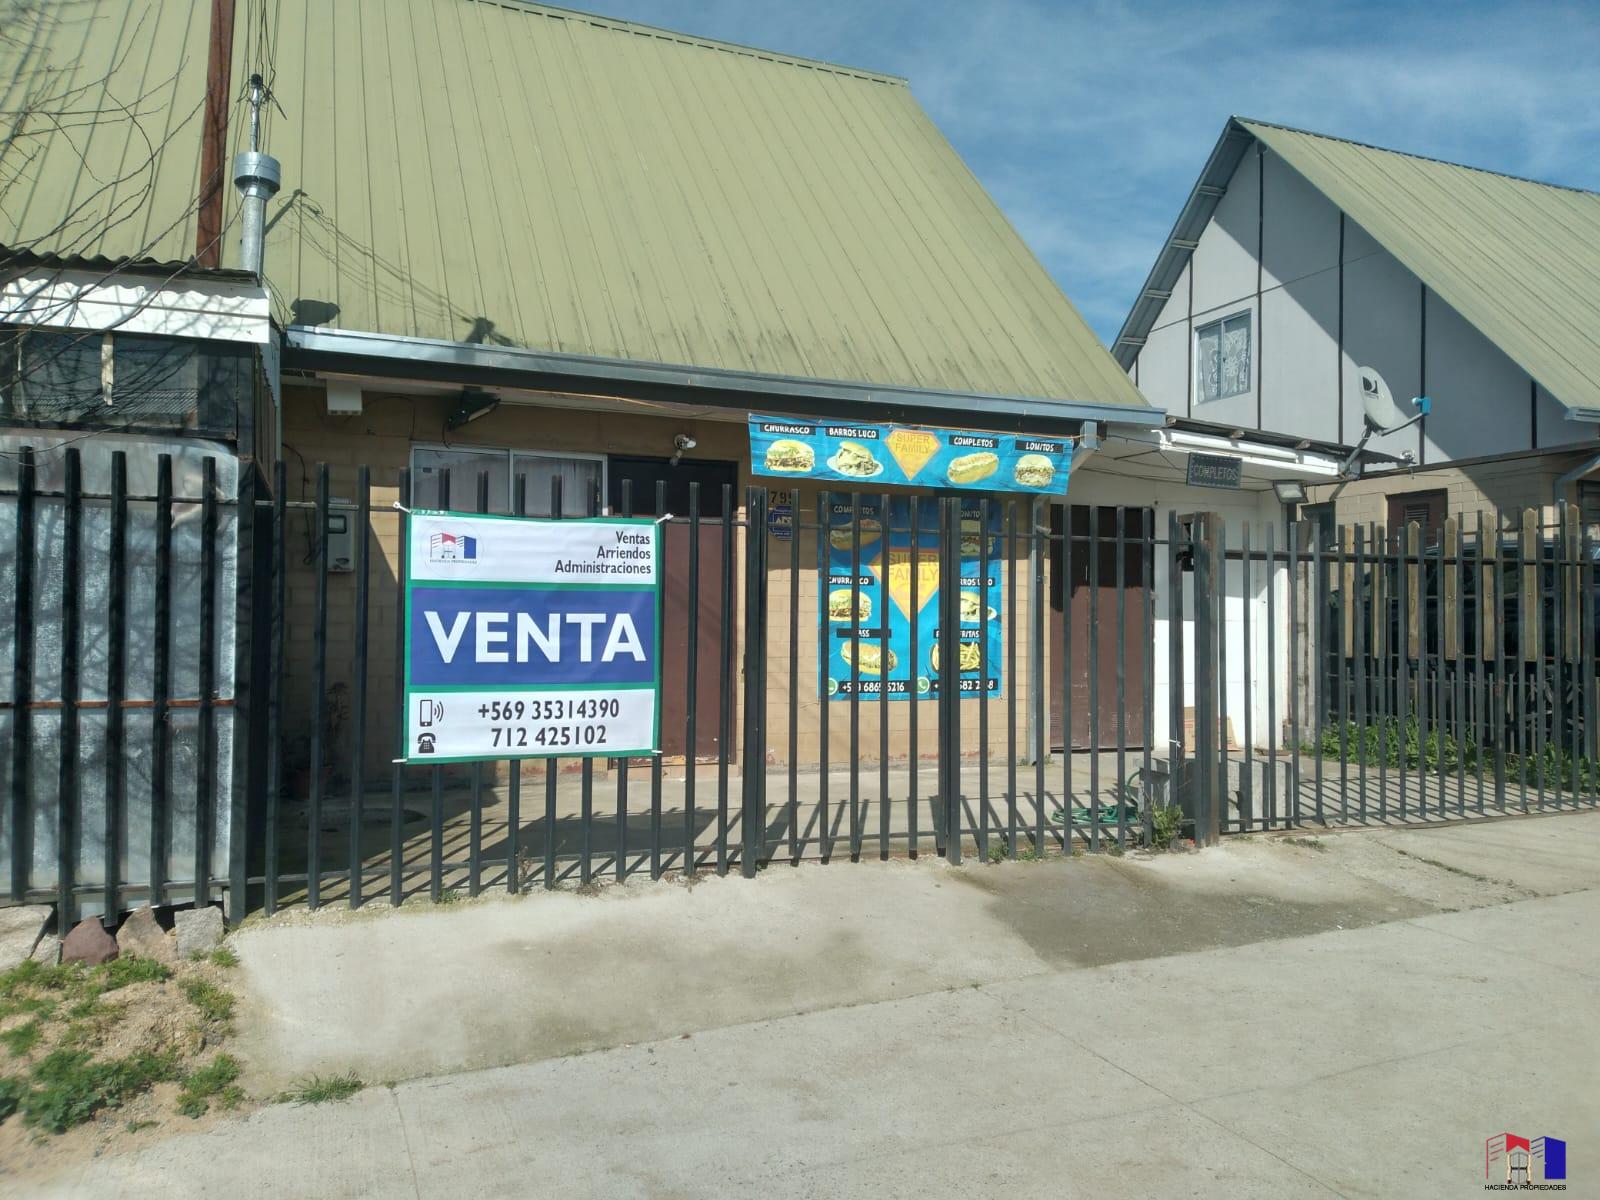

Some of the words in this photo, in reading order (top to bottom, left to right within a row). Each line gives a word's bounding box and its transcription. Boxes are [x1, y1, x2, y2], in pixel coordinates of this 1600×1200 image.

[764, 424, 810, 434] CHURRASCO
[829, 427, 857, 437] BARROS
[858, 429, 877, 439] LUCO
[896, 432, 930, 444] SUPER
[953, 437, 994, 448] COMPLETOS
[895, 443, 930, 454] FAMILY
[1025, 442, 1055, 452] LOMITOS
[1193, 463, 1239, 481] COMPLETOS
[615, 531, 650, 545] Ventas
[596, 546, 651, 560] Arriendos
[554, 560, 652, 575] Administraciones
[423, 611, 647, 664] VENTA
[478, 701, 525, 721] +569
[531, 698, 620, 719] 35314390
[491, 727, 528, 747] 712
[535, 725, 607, 745] 425102
